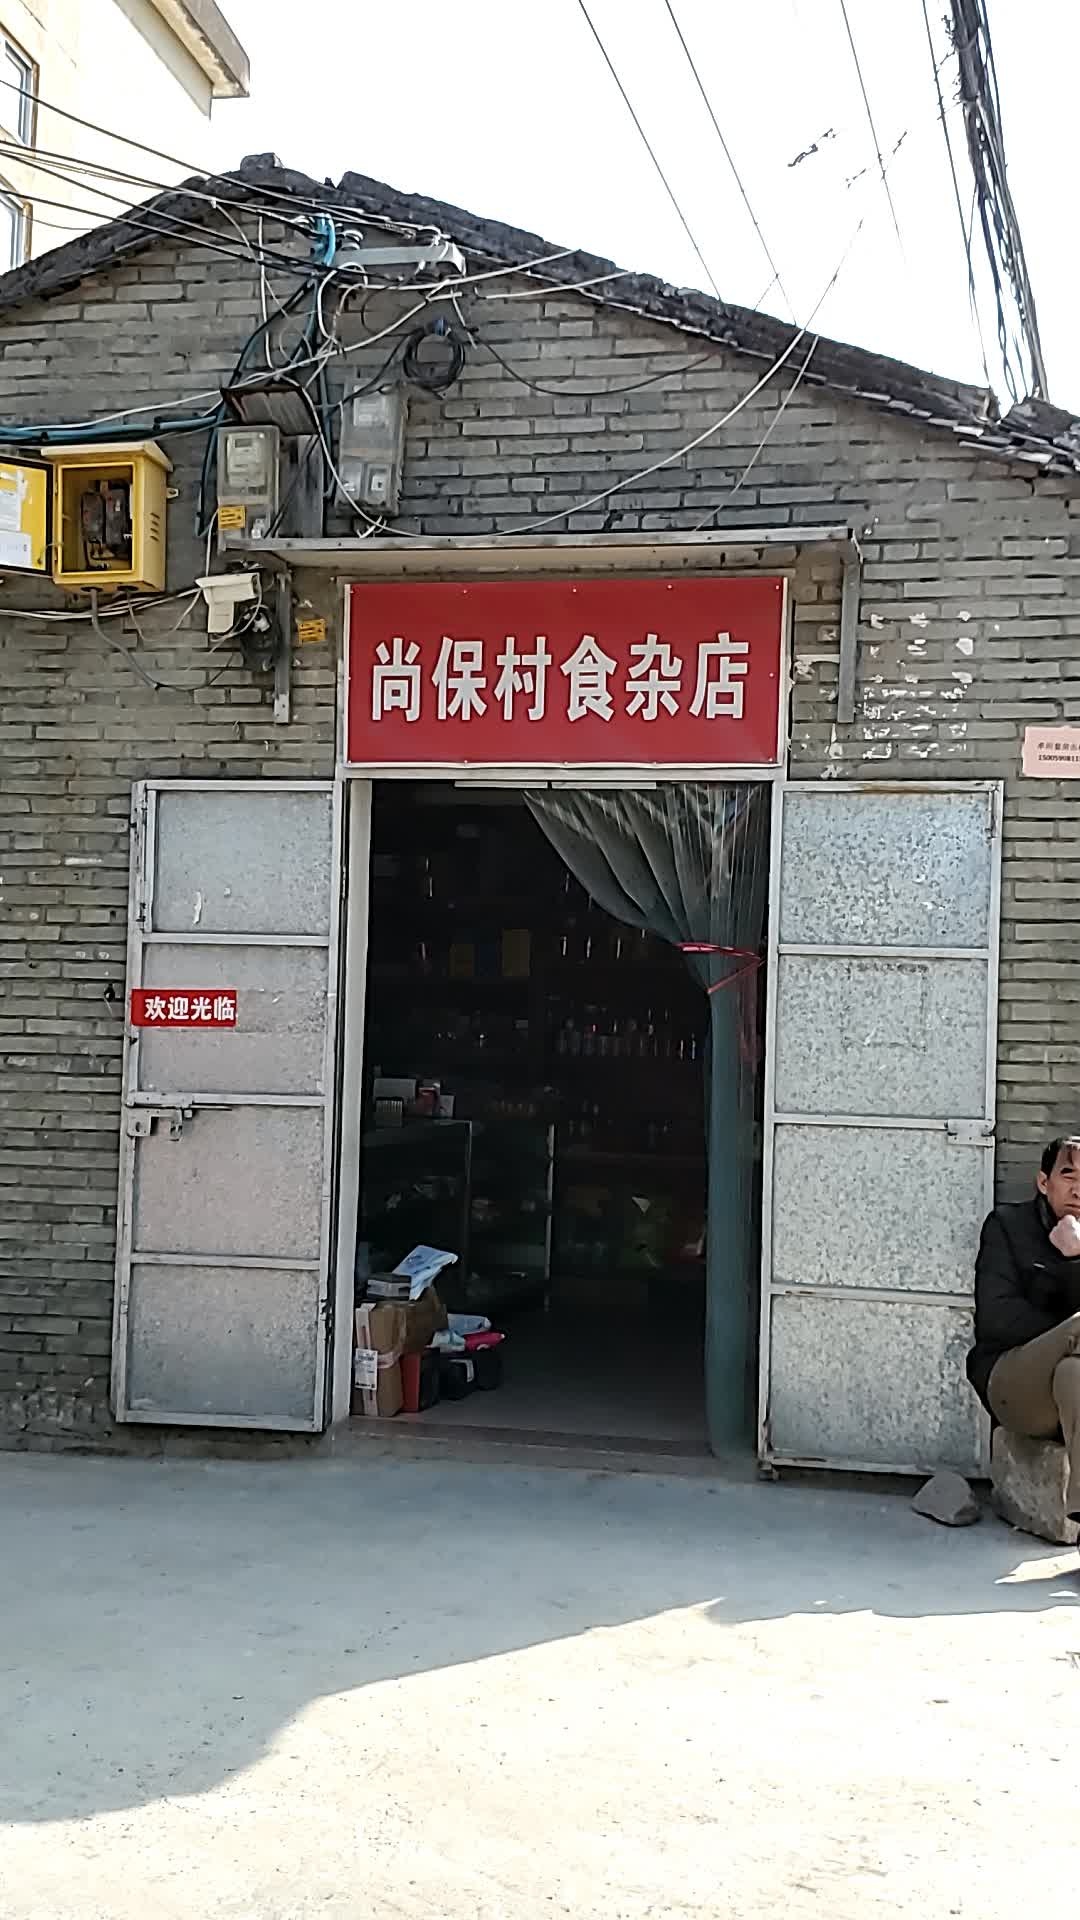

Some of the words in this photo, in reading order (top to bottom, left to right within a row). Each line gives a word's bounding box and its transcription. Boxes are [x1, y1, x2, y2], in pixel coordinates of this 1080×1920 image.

[371, 632, 749, 721] 尚保村食杂店
[144, 996, 235, 1020] 欢迎光临
